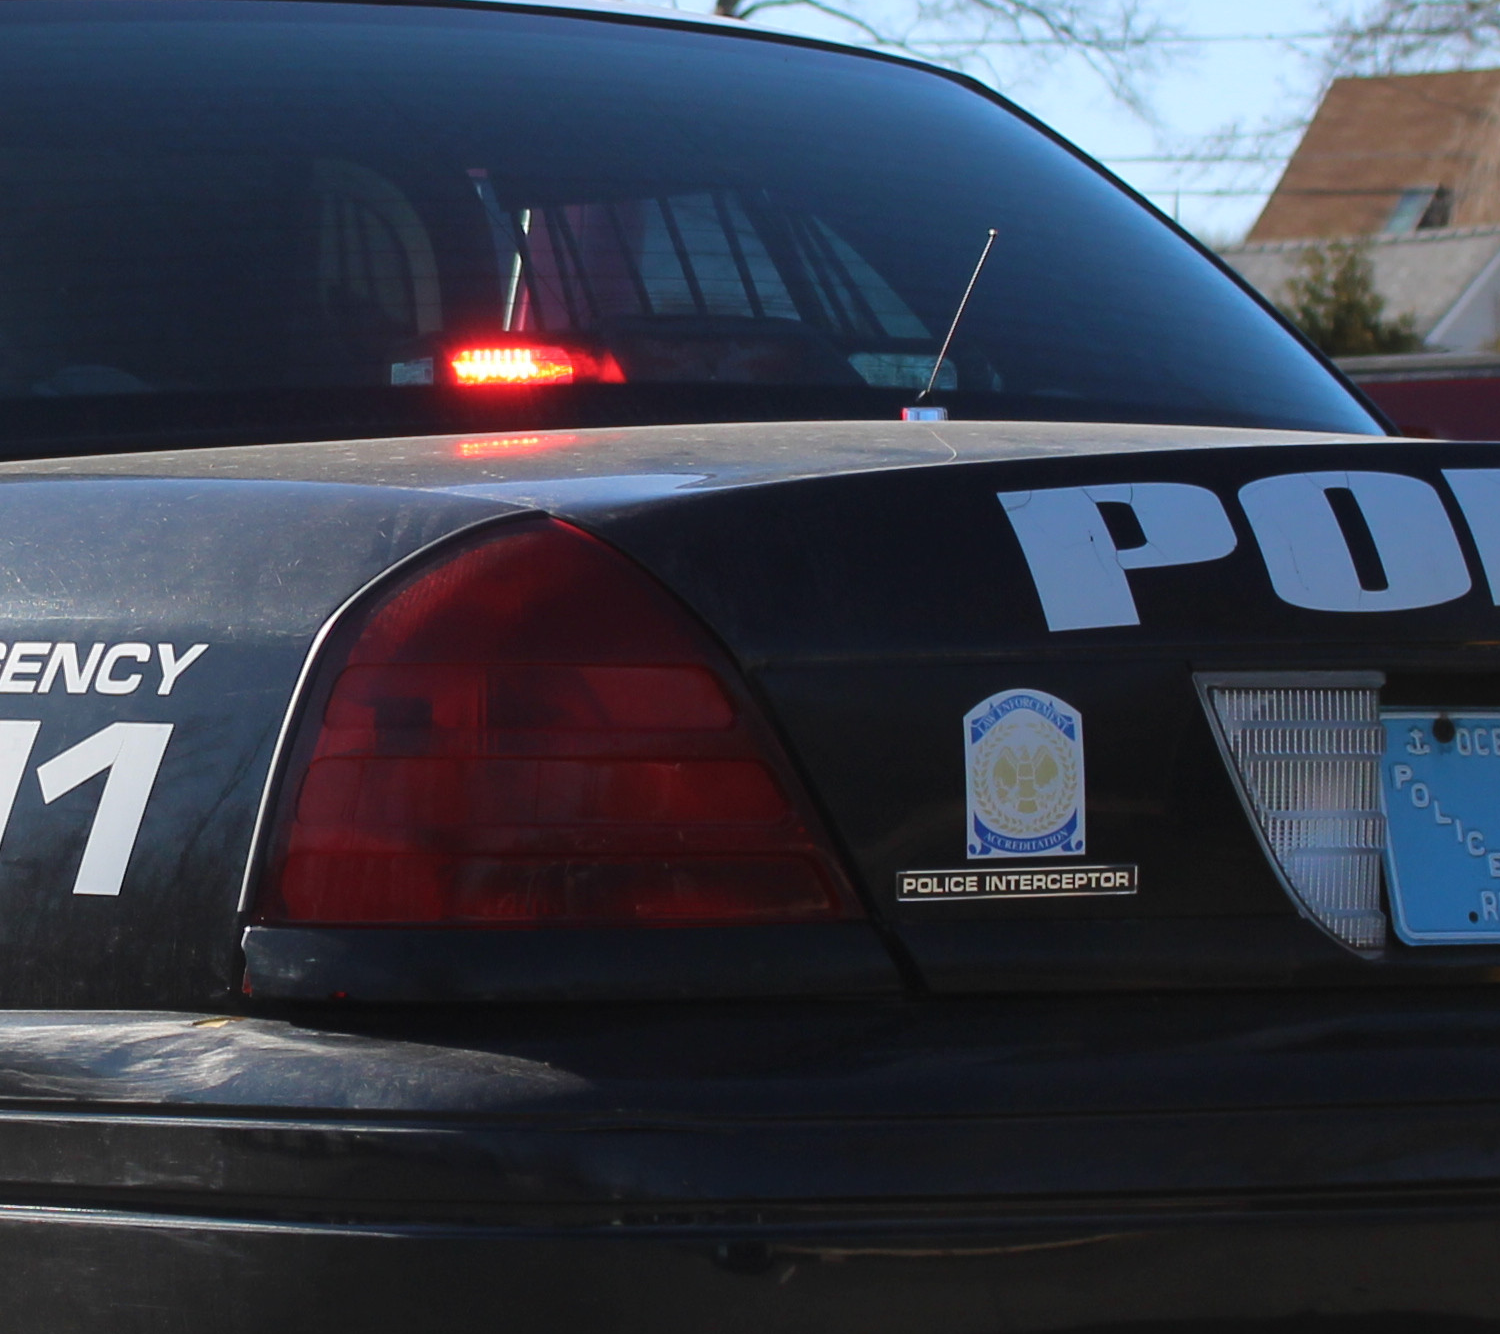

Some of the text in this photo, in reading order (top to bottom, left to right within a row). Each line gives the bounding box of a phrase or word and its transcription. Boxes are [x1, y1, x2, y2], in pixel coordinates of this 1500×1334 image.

[978, 696, 1068, 736] LAW ENFORCEMENT
[984, 828, 1069, 852] ACCREDITATION
[903, 871, 1129, 894] POLICE INTERCEPTOR
